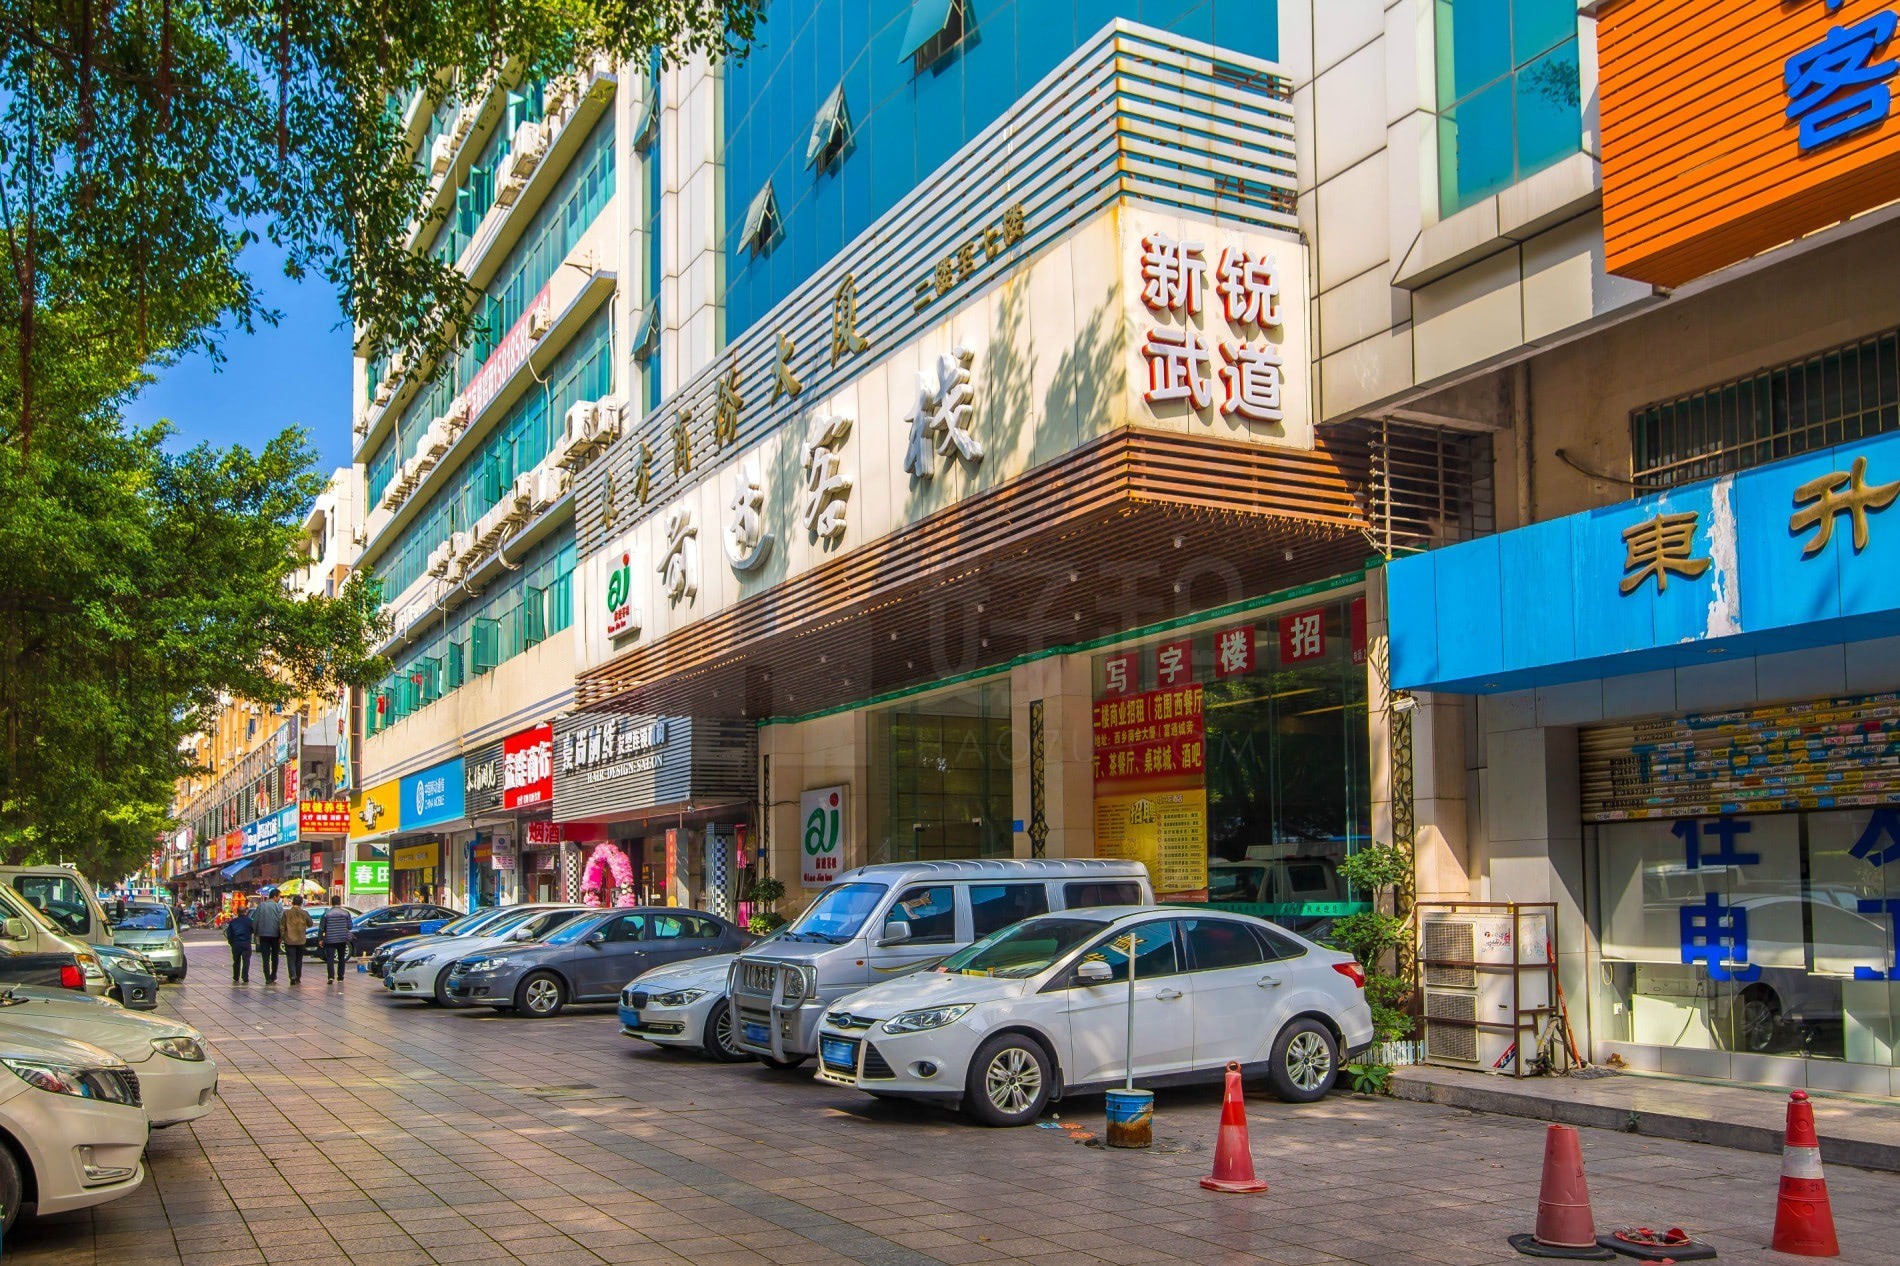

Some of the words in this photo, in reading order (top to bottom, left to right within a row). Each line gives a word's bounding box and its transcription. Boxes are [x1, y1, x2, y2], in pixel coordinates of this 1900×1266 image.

[1784, 10, 1900, 153] 客
[1141, 232, 1284, 330] 新锐
[1143, 329, 1284, 423] 武道
[529, 821, 561, 844] 烟酒
